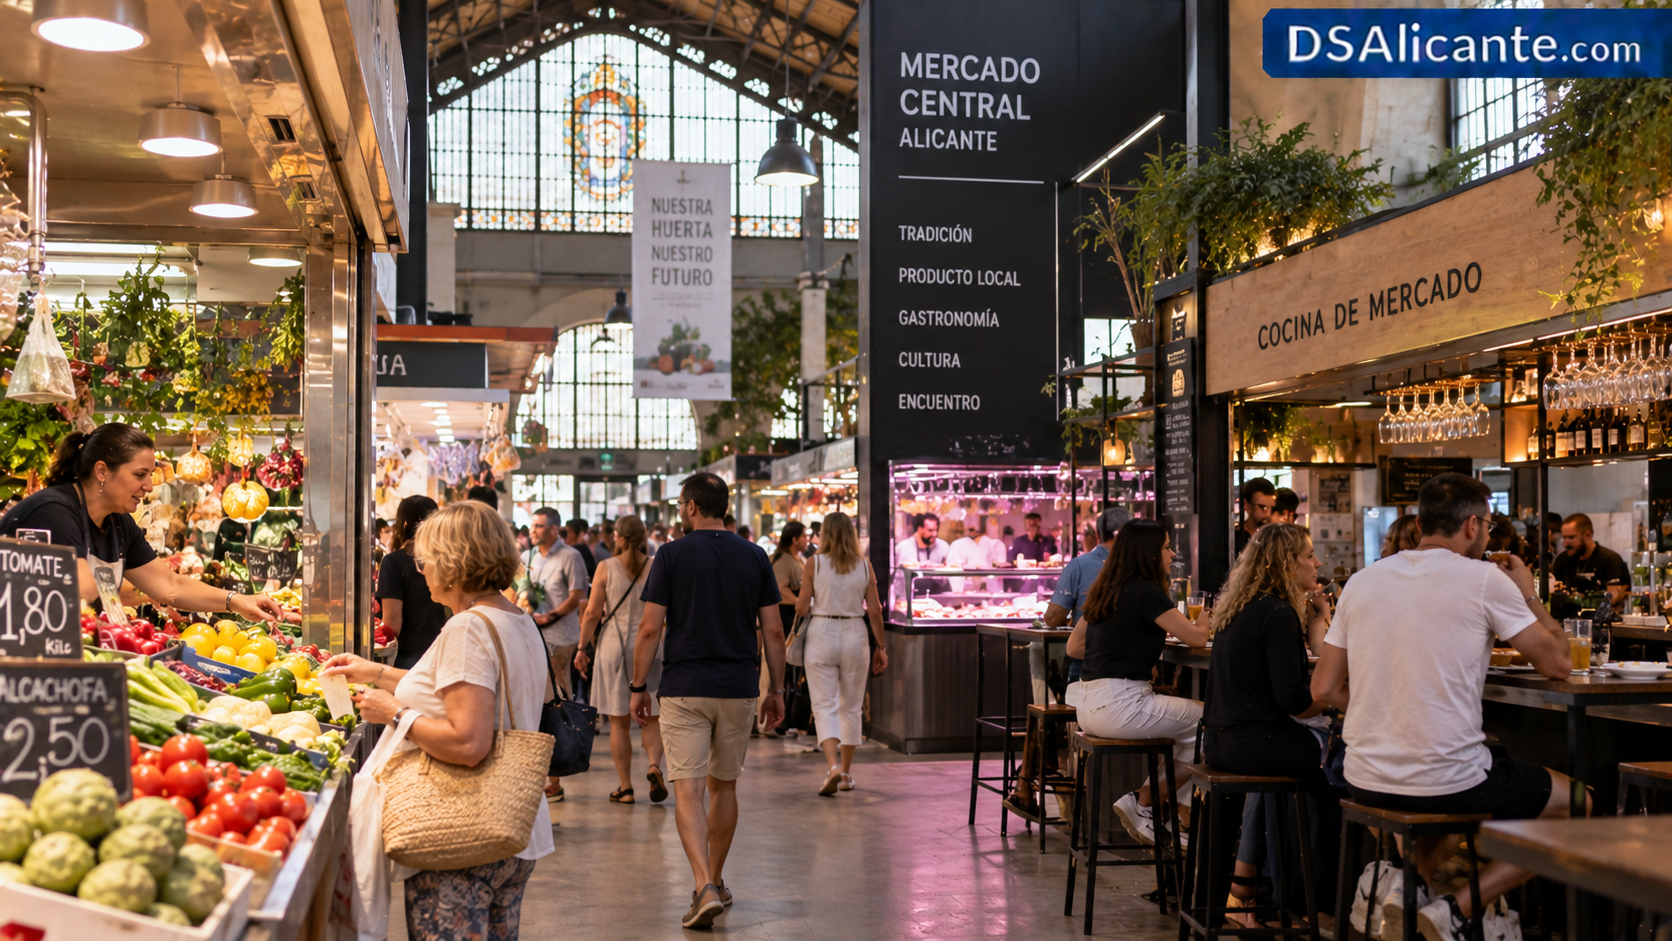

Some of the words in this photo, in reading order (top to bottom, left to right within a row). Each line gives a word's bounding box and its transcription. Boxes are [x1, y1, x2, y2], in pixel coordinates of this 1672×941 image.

[900, 51, 1041, 84] MERCADO
[899, 88, 1031, 120] CENTRAL
[899, 127, 998, 152] ALICANTE
[651, 197, 713, 216] NUESTRA
[651, 220, 713, 239] HUERTA
[899, 224, 973, 243] TRADICIÓN
[651, 244, 713, 263] NUESTRO
[651, 266, 713, 287] FUTURO
[899, 267, 973, 285] PRODUCTO
[977, 269, 1021, 287] LOCAL
[1257, 308, 1326, 351] COCINA
[1334, 298, 1359, 331] DE
[1369, 261, 1483, 321] MERCADO
[899, 308, 1000, 328] GASTRONOMÍA
[899, 351, 961, 368] CULTURA
[898, 393, 981, 411] ENCUENTRO
[0, 549, 64, 579] TOMATE
[0, 581, 68, 646] 1,80
[0, 674, 109, 704] ALCACHOFA
